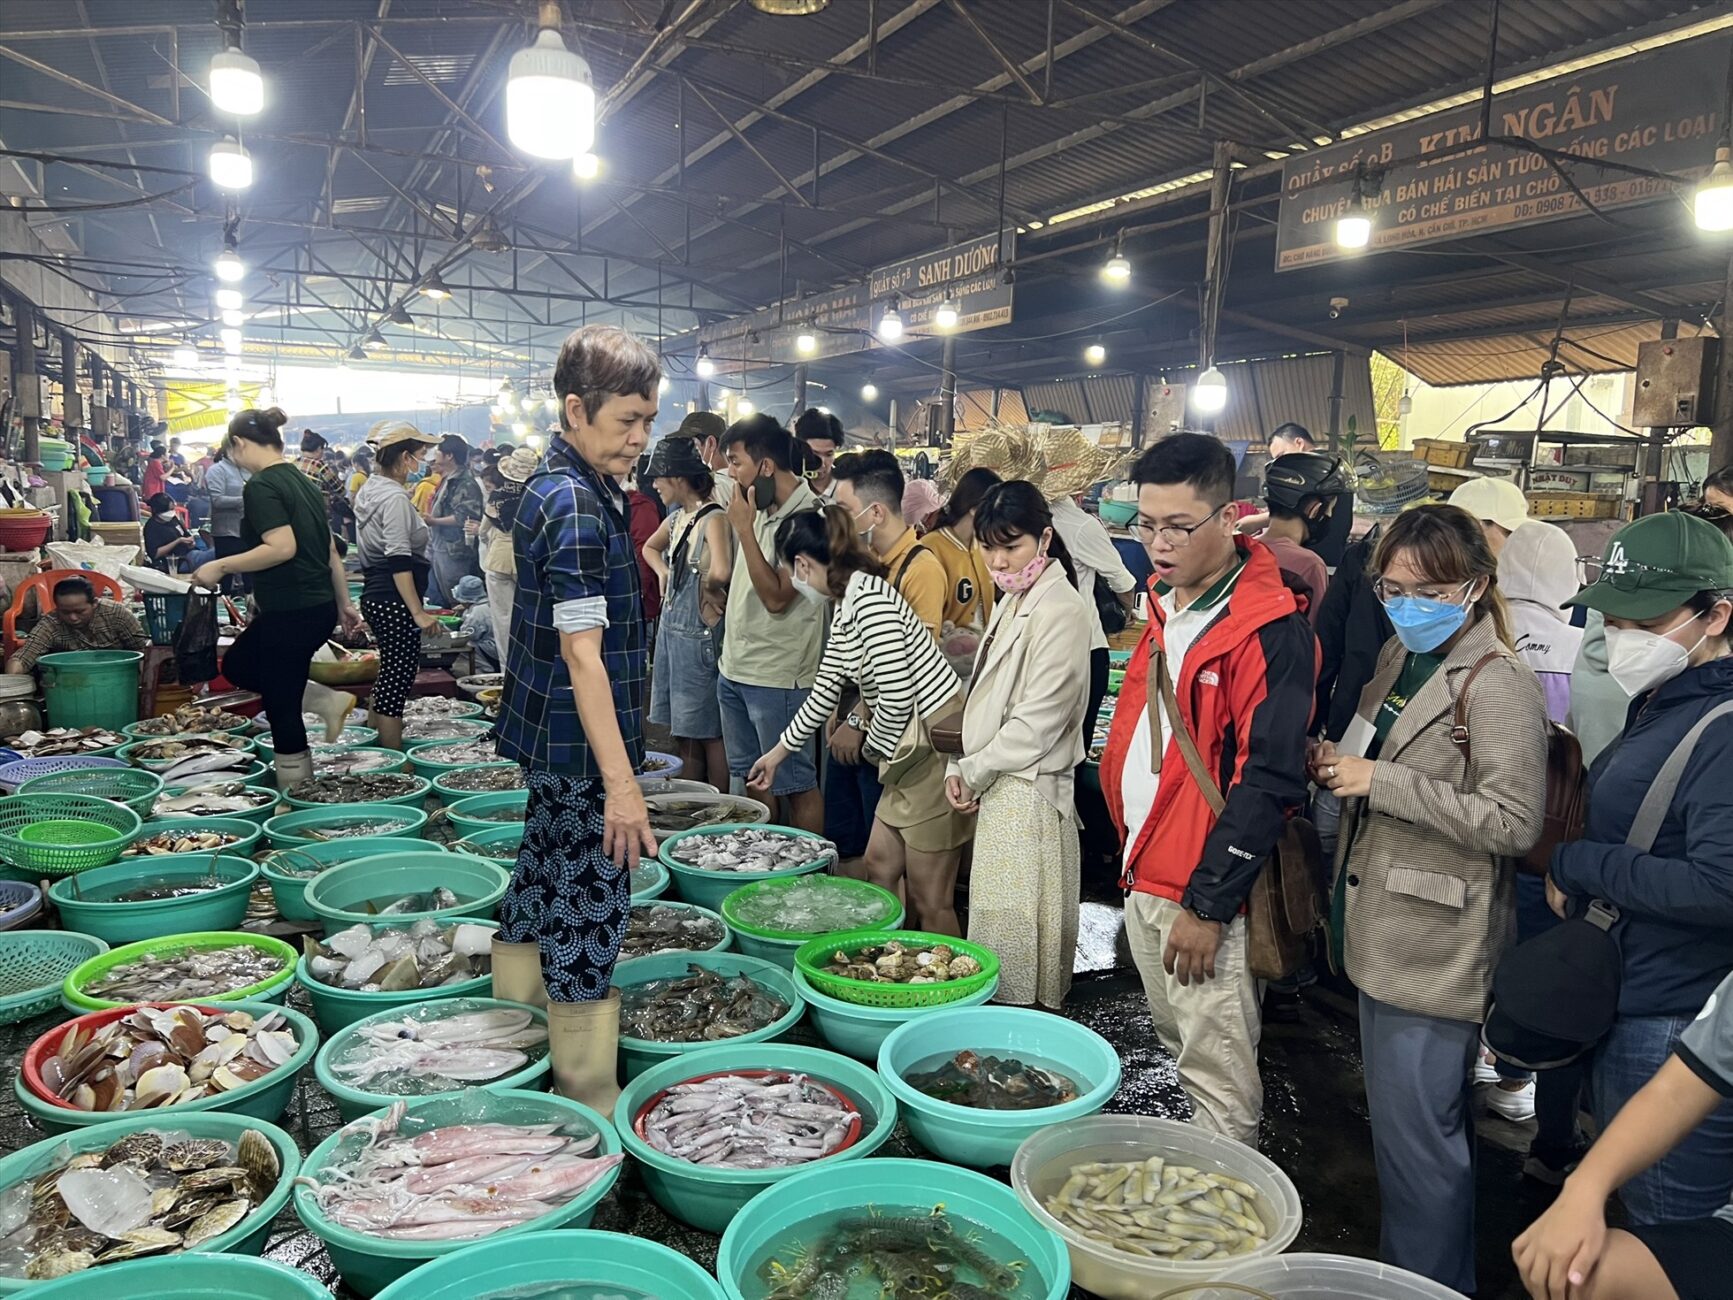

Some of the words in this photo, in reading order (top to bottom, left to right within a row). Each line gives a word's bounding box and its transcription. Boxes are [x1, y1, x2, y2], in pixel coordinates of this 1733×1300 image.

[1503, 85, 1618, 140] NGÂN
[1396, 178, 1428, 202] BÁN
[1433, 168, 1462, 194] HẢI
[1466, 159, 1501, 185] SẢN
[1614, 125, 1657, 152] CÁC
[1664, 112, 1717, 142] LOẠI
[1398, 204, 1417, 223] CÓ
[1421, 194, 1452, 218] CHẾ
[1455, 187, 1490, 212] BIẾN
[1495, 184, 1521, 203] TẠI
[1536, 196, 1564, 214] 0908
[919, 258, 951, 287] SANH
[1559, 475, 1578, 486] DUY
[1607, 541, 1628, 574] LA
[956, 577, 974, 605] G
